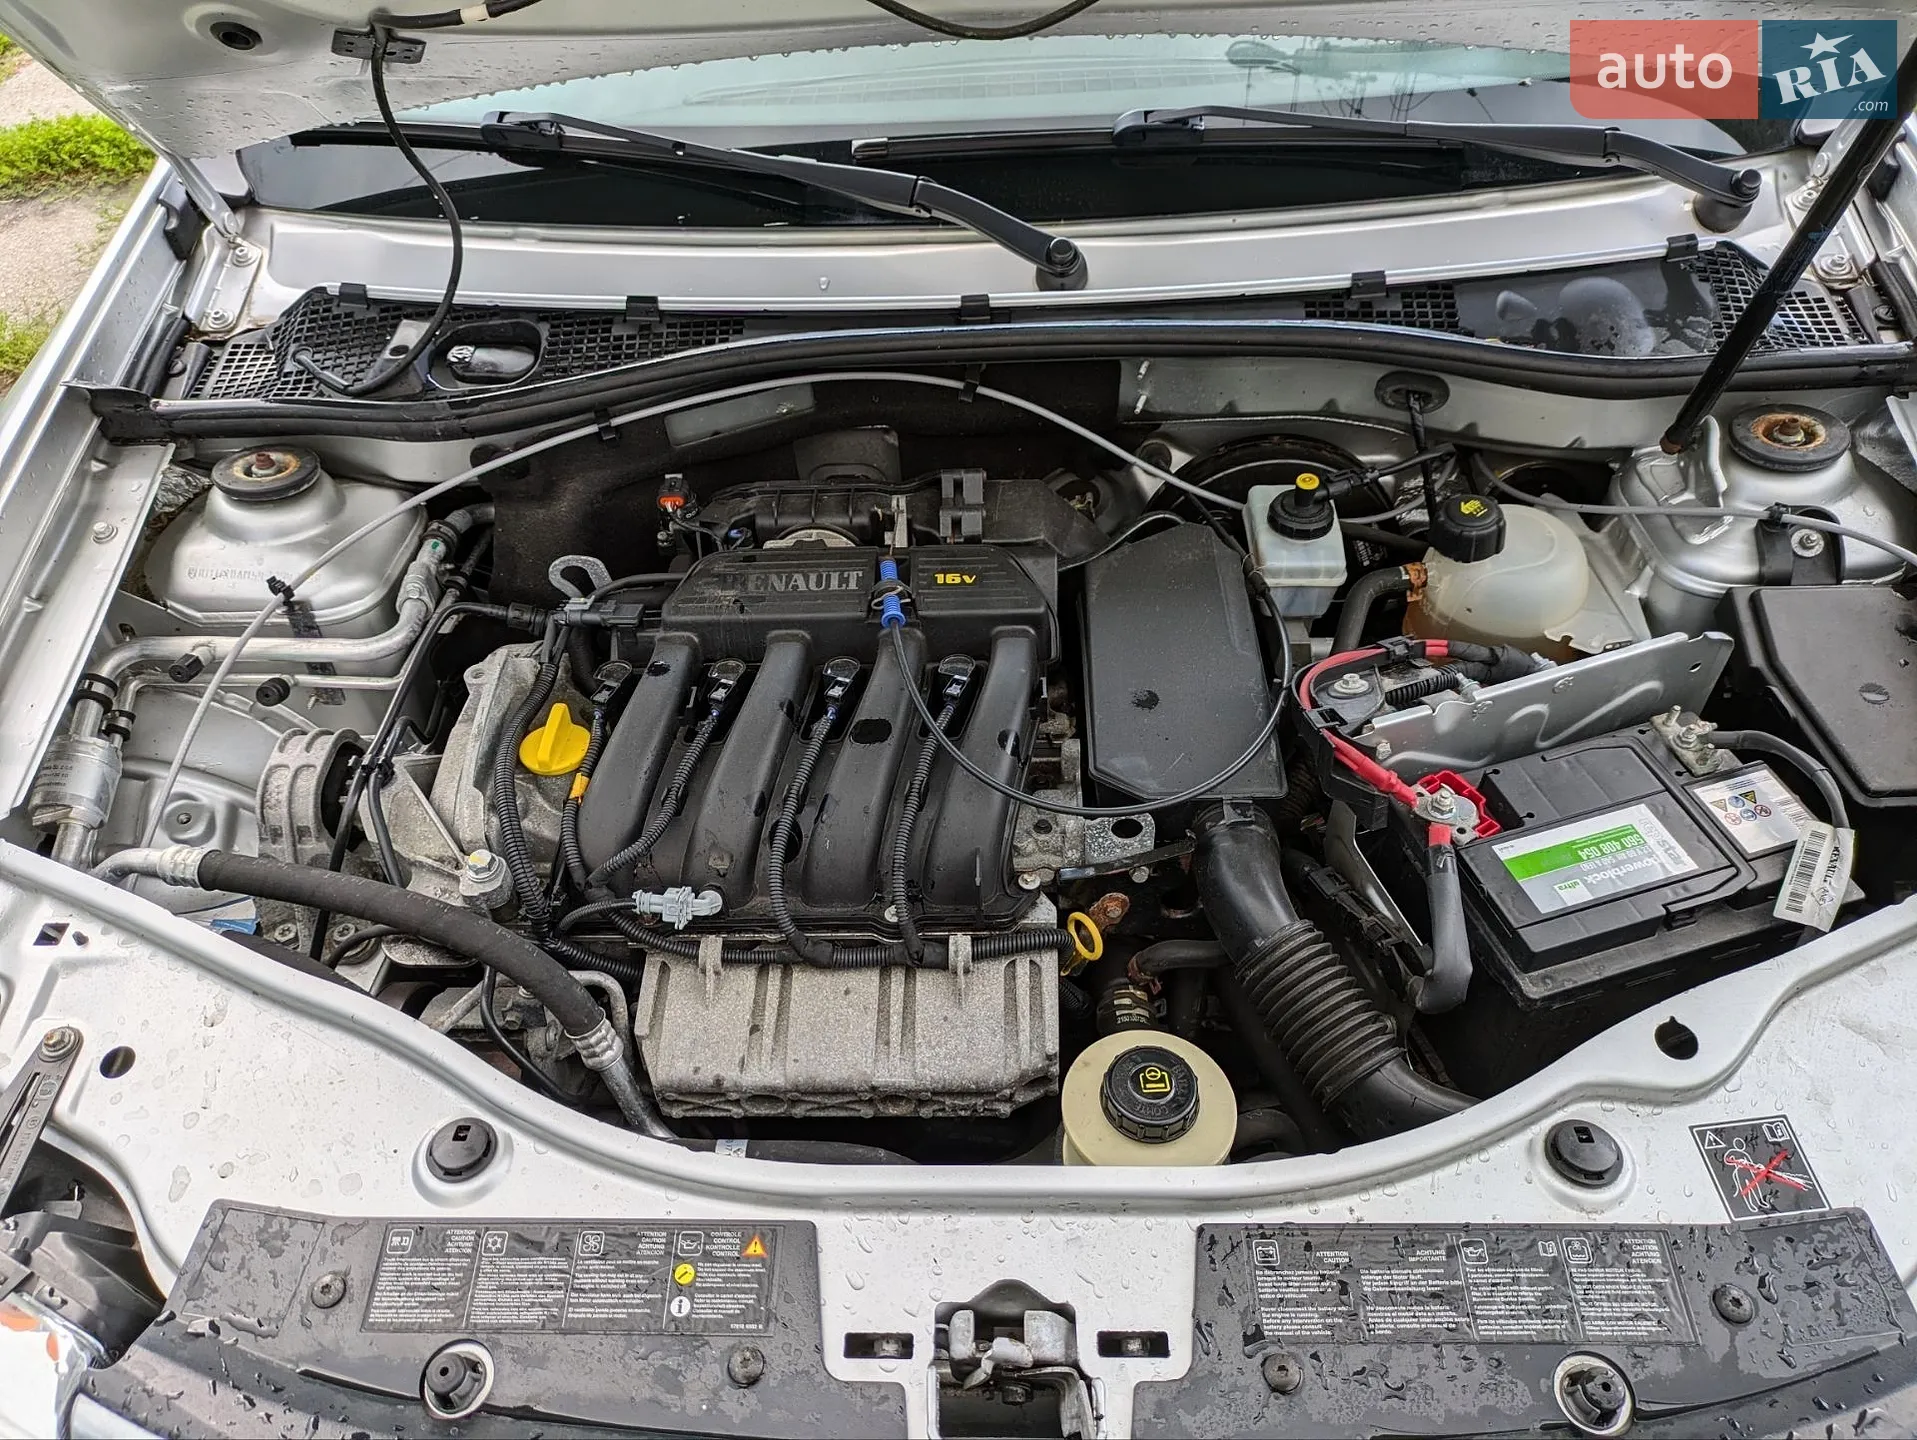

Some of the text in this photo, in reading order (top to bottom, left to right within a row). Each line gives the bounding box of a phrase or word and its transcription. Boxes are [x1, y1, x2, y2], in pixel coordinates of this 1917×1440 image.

[728, 571, 863, 592] RENAULT
[1599, 840, 1622, 854] 408
[1620, 834, 1645, 848] 560
[1577, 846, 1601, 861] 054
[1583, 854, 1662, 885] powerblock
[1557, 881, 1581, 891] ultra
